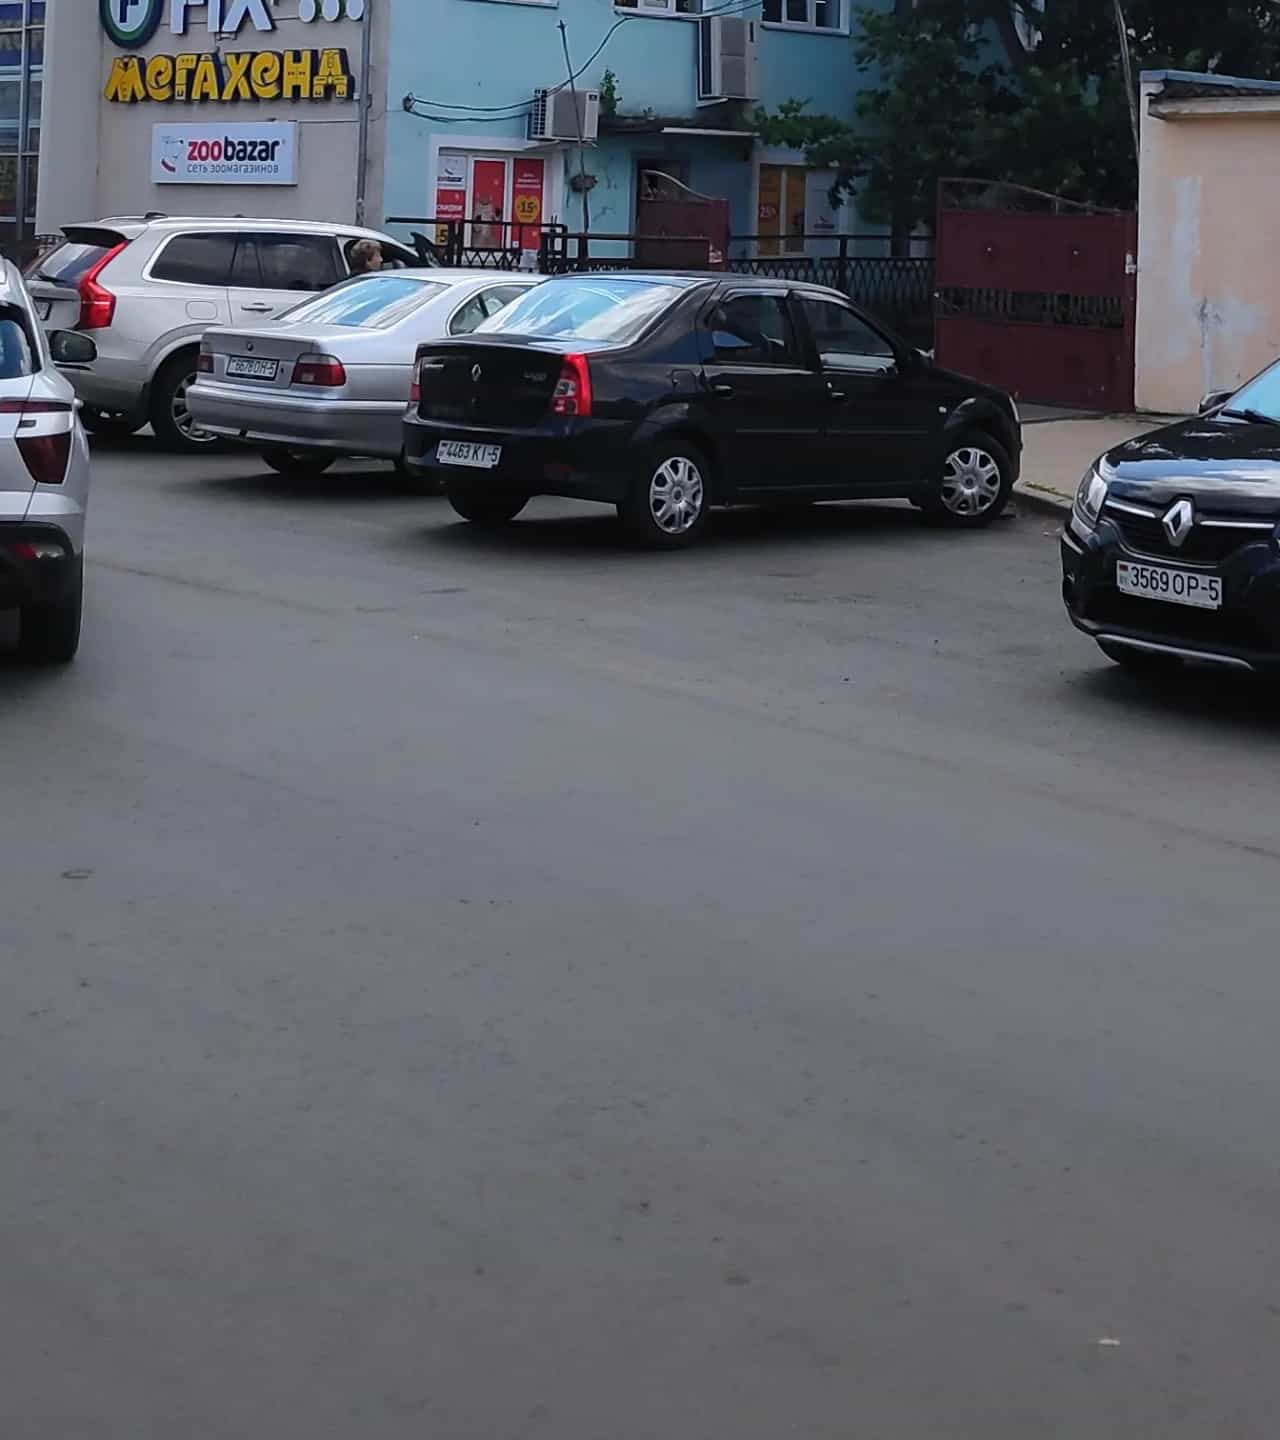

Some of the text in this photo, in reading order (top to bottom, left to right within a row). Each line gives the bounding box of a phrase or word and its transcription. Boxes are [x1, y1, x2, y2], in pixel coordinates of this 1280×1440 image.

[187, 136, 281, 161] zoobazar
[187, 164, 207, 174] сеть
[1131, 566, 1169, 592] 3569
